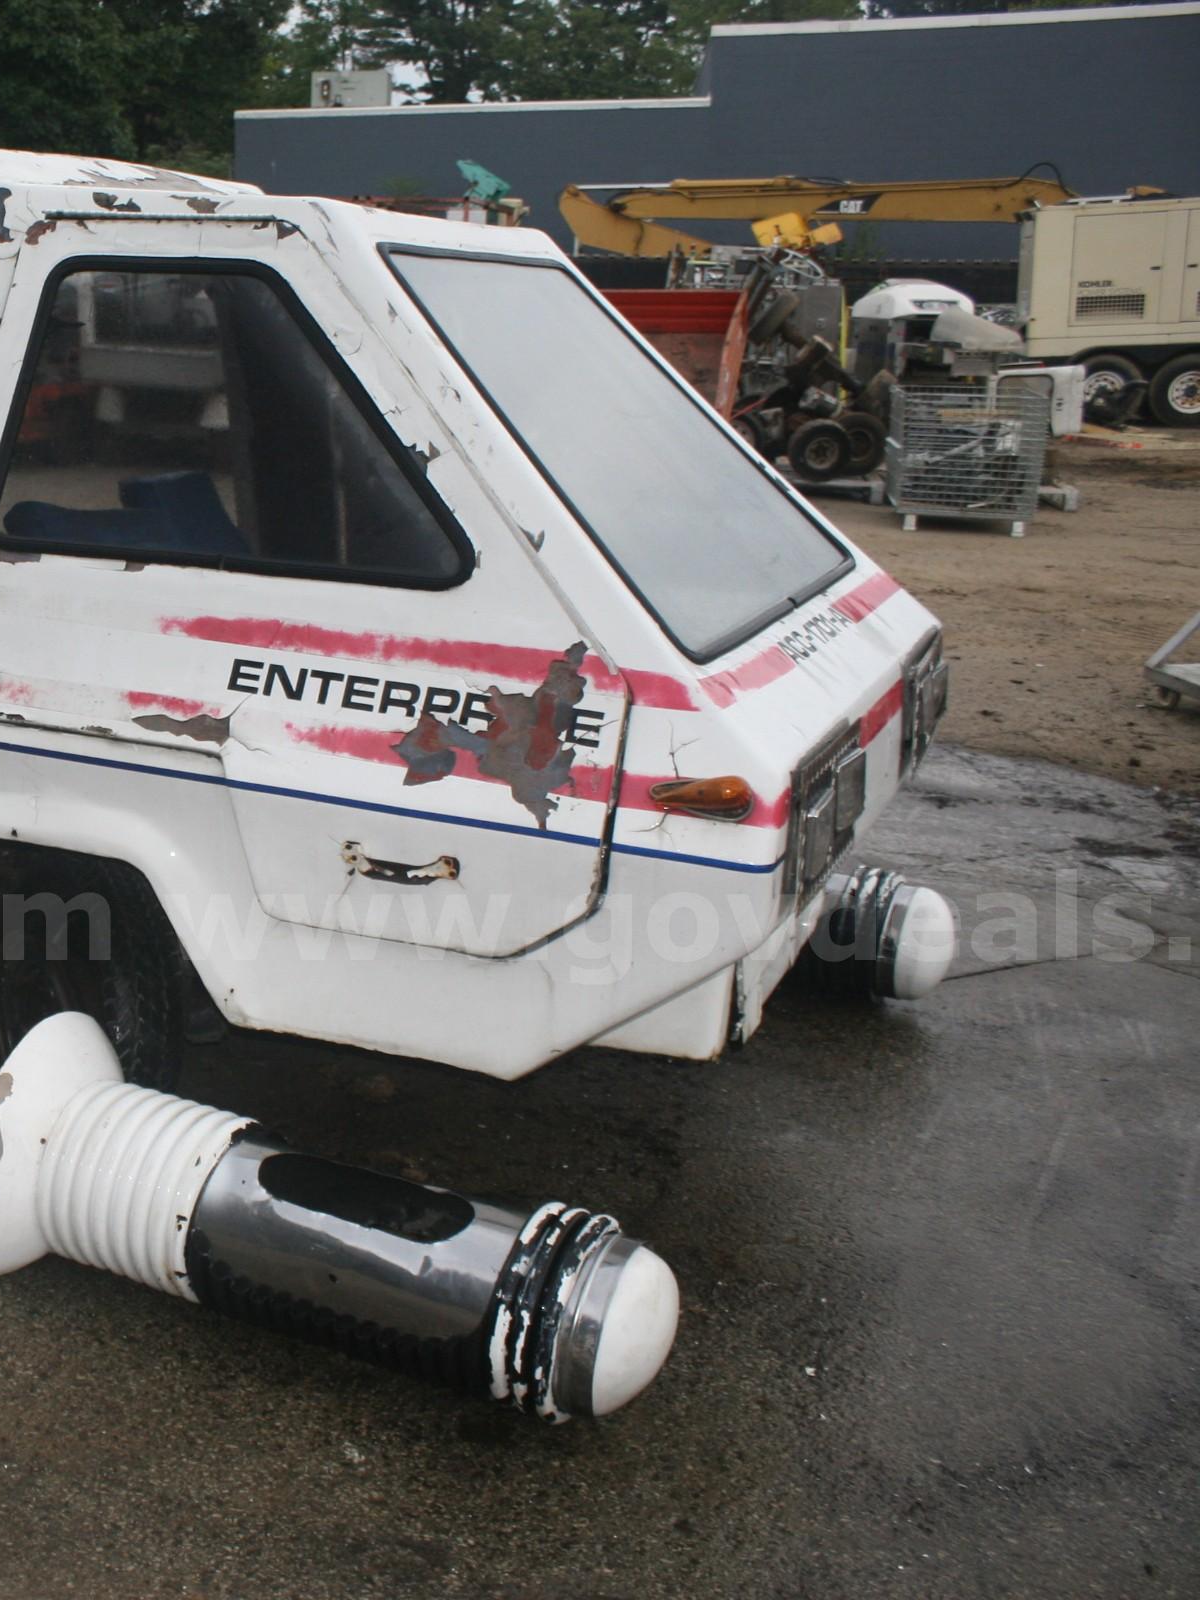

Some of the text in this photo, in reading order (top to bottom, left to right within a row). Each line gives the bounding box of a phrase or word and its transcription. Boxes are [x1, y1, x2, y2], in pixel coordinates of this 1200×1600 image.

[839, 199, 864, 214] CAT
[1077, 280, 1113, 289] KOHLER
[226, 657, 606, 749] ENTERPRE
